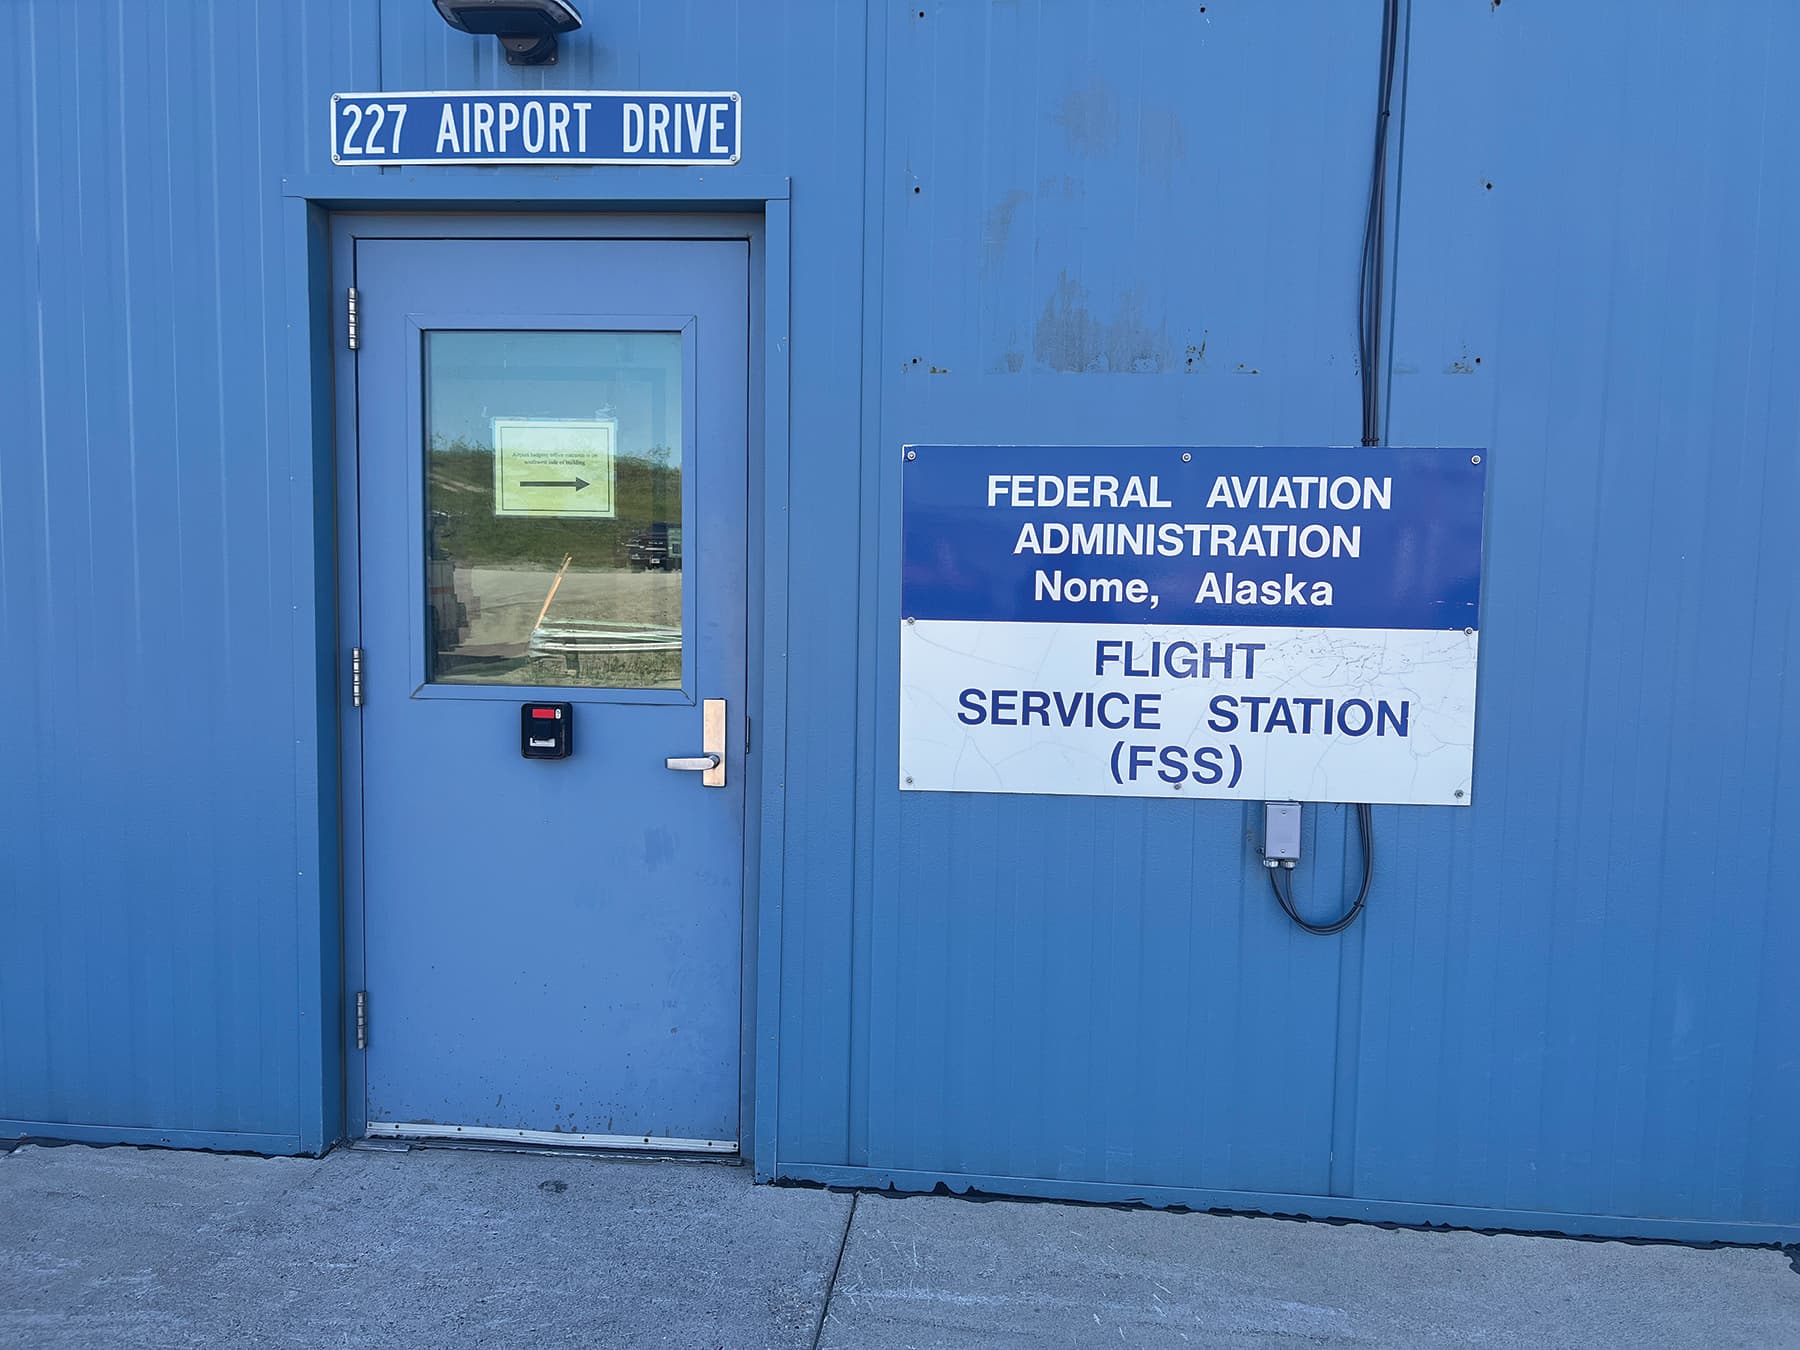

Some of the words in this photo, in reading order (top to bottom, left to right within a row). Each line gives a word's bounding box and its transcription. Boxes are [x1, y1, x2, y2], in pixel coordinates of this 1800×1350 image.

[342, 104, 407, 154] 227
[436, 101, 592, 153] AIRPORT
[623, 103, 729, 154] DRIVE
[987, 475, 1172, 508] FEDERAL
[1206, 475, 1392, 510] AVIATION
[1013, 523, 1361, 558] ADMINISTRATION
[1034, 570, 1159, 609] Nome,
[1195, 572, 1333, 606] Alaska
[1095, 640, 1266, 679] FLIGHT
[957, 689, 1162, 730] SERVICE
[1207, 694, 1410, 737] STATION
[1110, 740, 1243, 788] (FSS)
